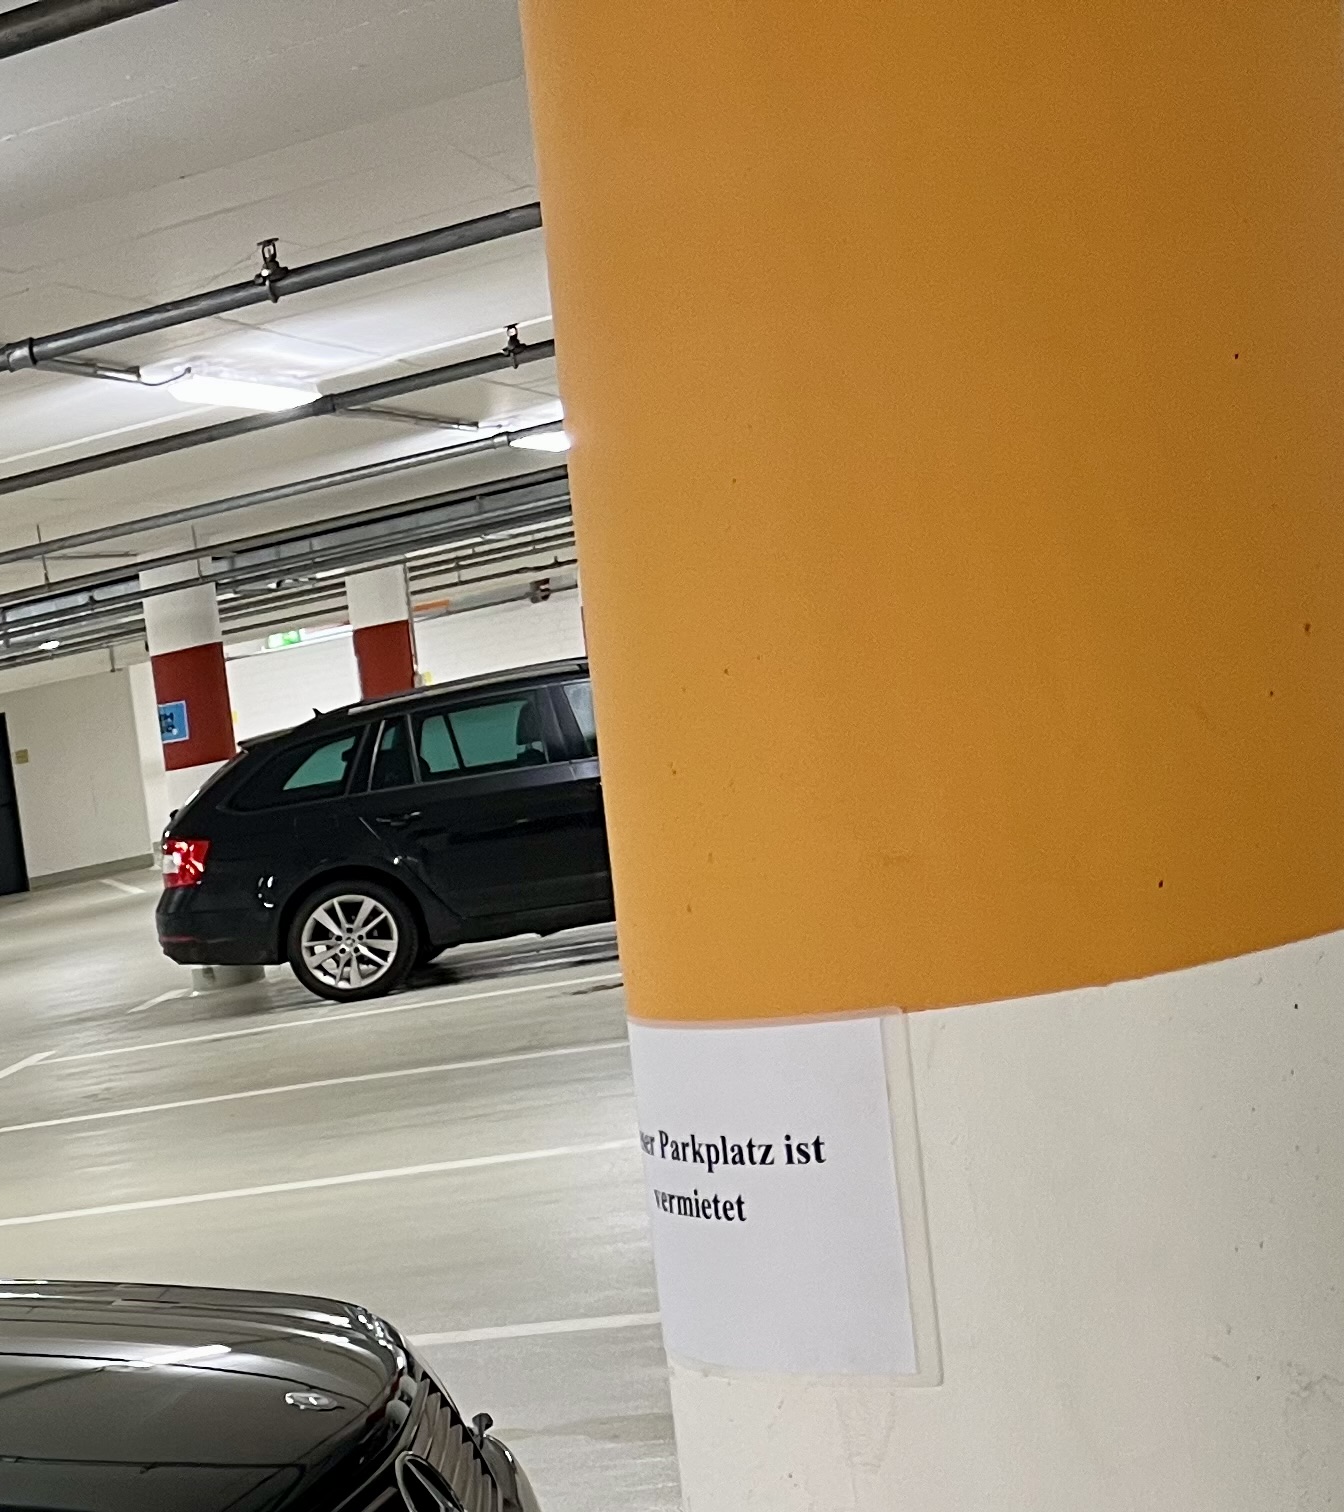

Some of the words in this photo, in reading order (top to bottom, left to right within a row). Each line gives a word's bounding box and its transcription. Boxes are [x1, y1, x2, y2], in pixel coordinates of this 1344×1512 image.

[658, 1130, 775, 1173] Parkplatz
[784, 1134, 827, 1165] ist
[653, 1189, 747, 1222] vermietet
